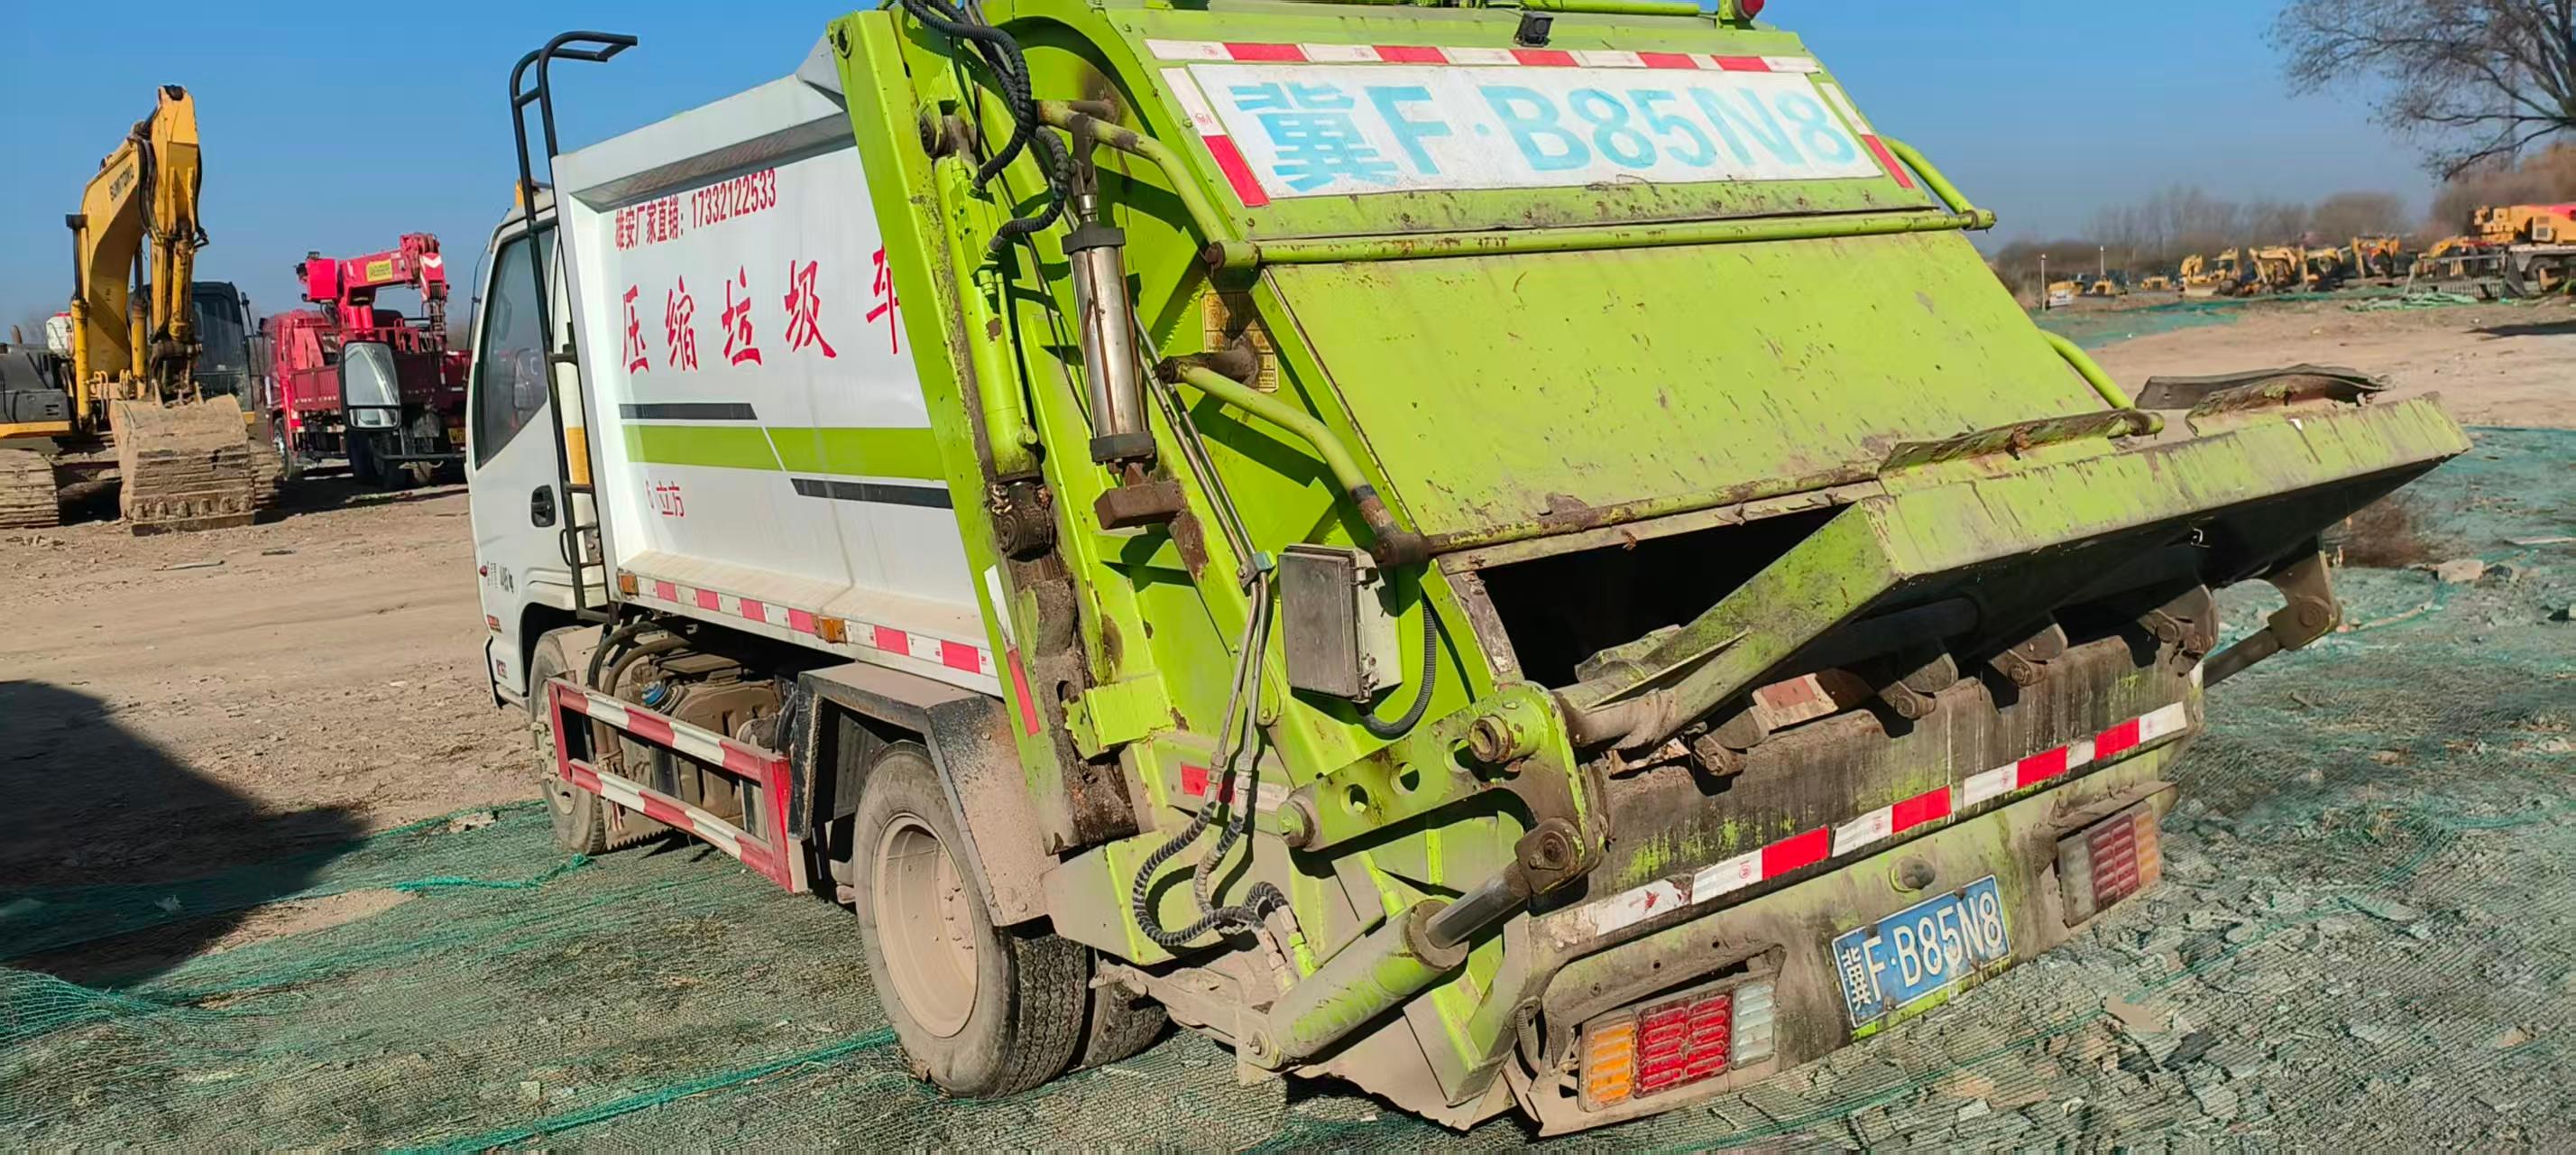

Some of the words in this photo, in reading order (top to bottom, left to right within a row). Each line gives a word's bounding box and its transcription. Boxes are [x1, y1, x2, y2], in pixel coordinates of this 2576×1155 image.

[1230, 82, 1856, 190] 冀F·B85N8
[691, 167, 777, 228] 17332122533
[1840, 891, 2002, 1011] 冀F·B85N8
